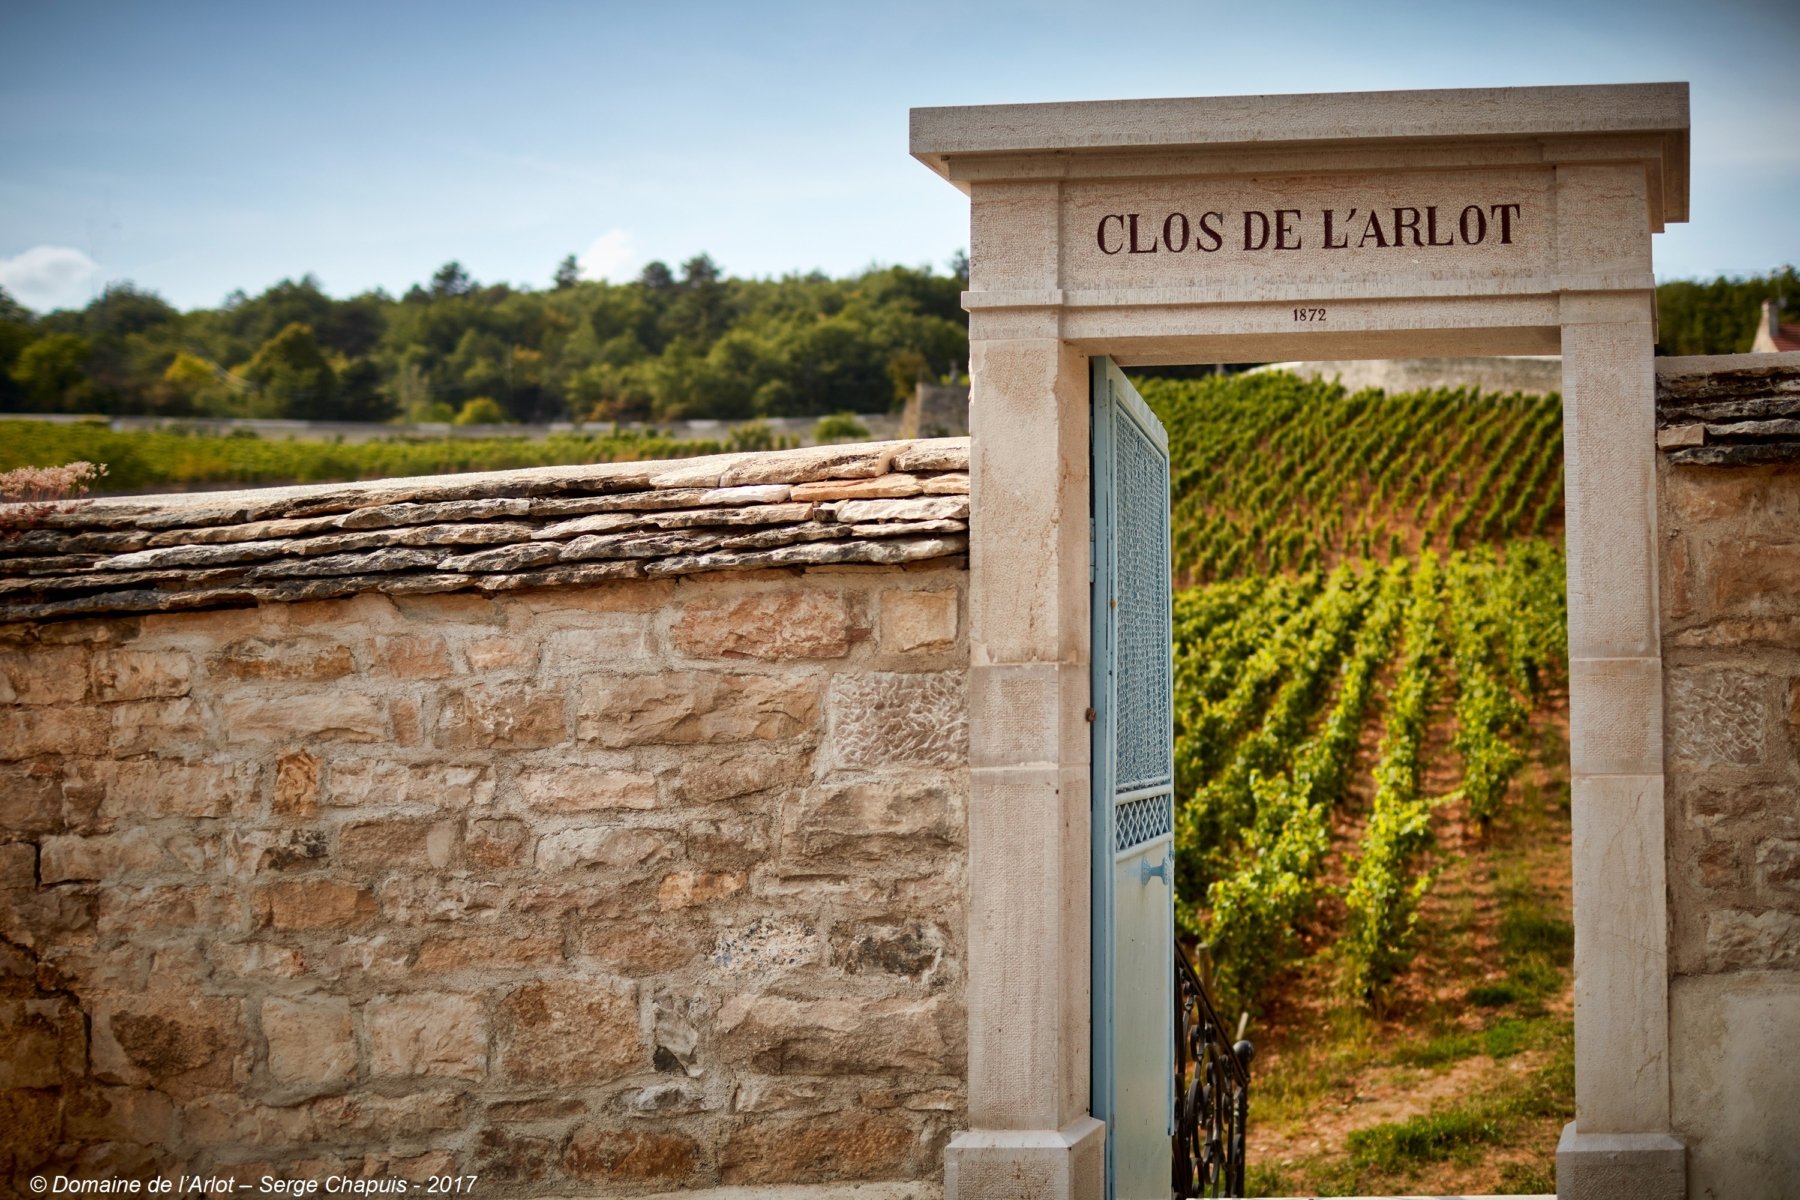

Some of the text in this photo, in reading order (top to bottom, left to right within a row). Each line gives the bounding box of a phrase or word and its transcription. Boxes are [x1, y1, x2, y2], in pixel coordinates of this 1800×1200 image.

[1096, 203, 1521, 255] CLOS DE L'ARLOT
[1293, 308, 1327, 322] 1872
